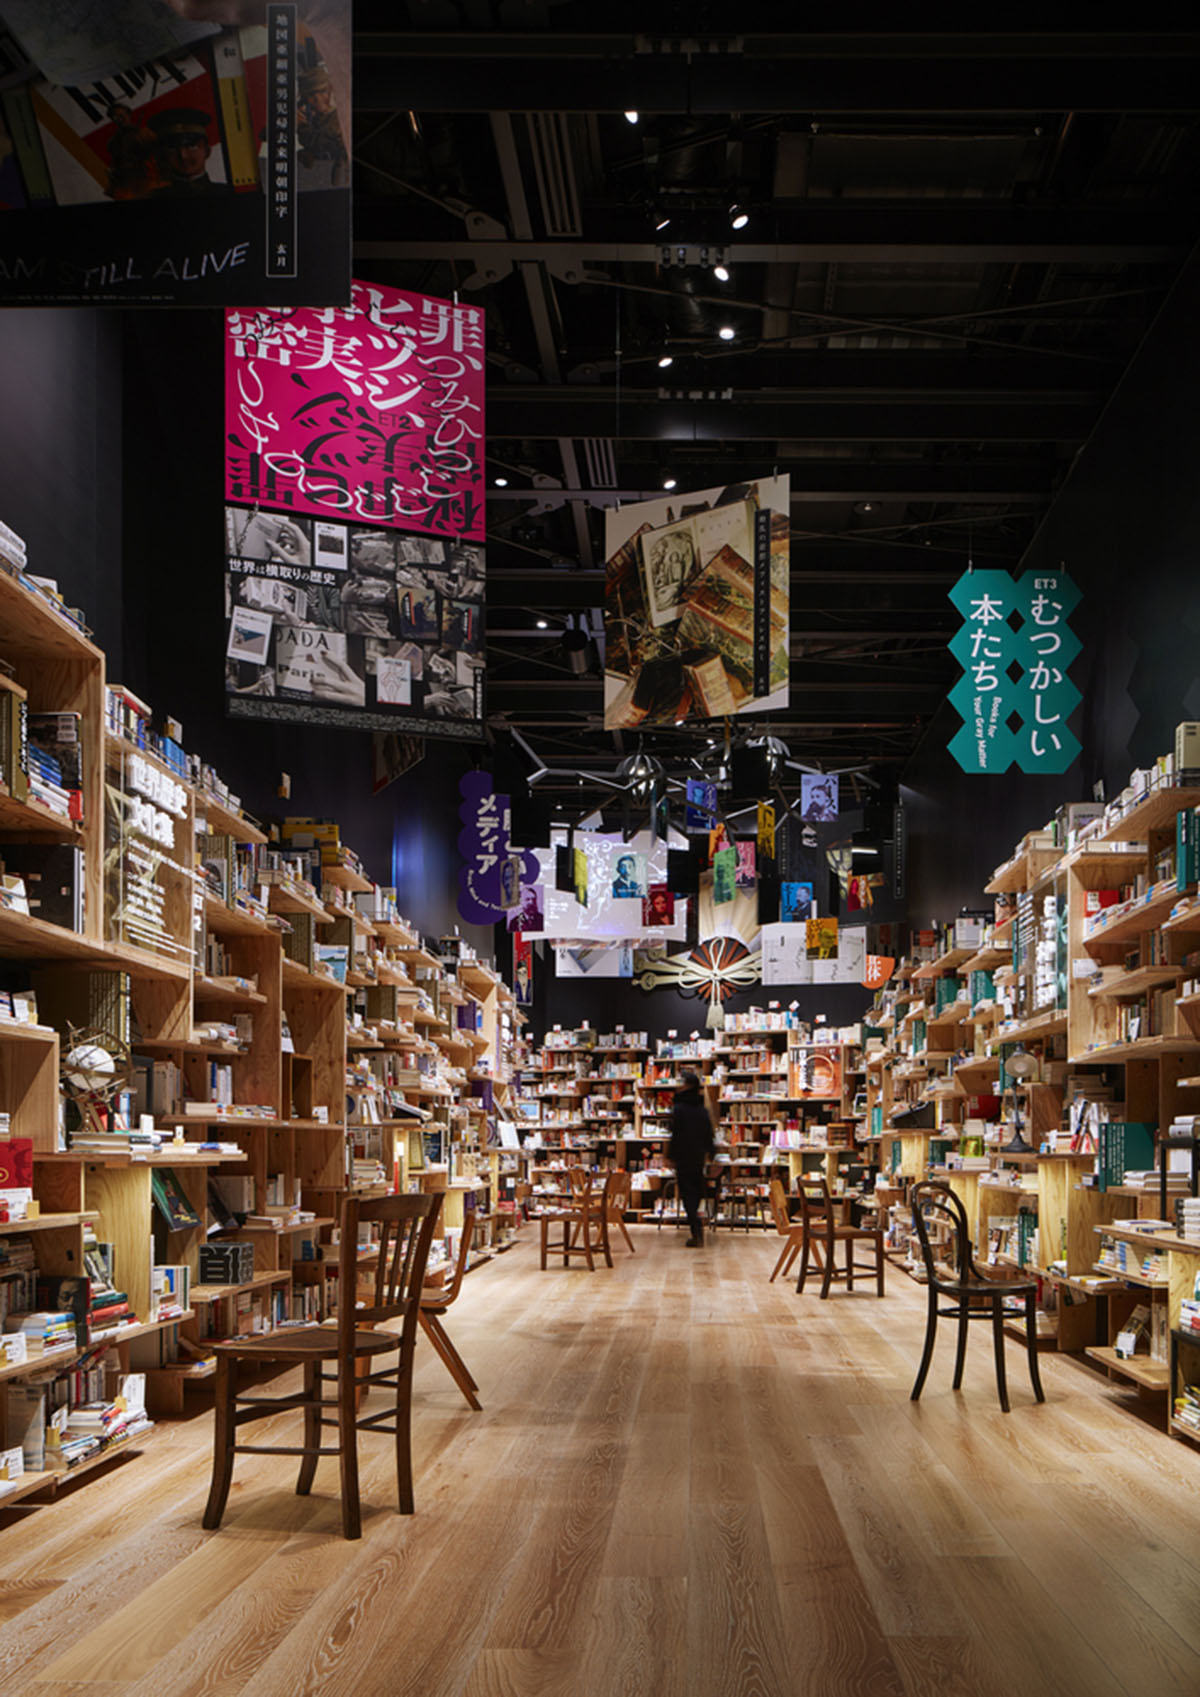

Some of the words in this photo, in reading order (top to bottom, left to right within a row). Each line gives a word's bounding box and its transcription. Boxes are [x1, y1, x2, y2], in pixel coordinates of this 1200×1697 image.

[152, 240, 251, 281] ALIVE
[379, 413, 411, 429] ET2
[228, 558, 336, 586] 世界は横取りの歴史
[1034, 578, 1057, 590] ET3
[969, 594, 1003, 692] 本たち
[1029, 594, 1063, 757] むつかしい
[973, 695, 983, 716] Your
[989, 696, 1002, 724] Books
[987, 724, 997, 738] for
[977, 740, 987, 768] Matter
[475, 793, 499, 875] メディア
